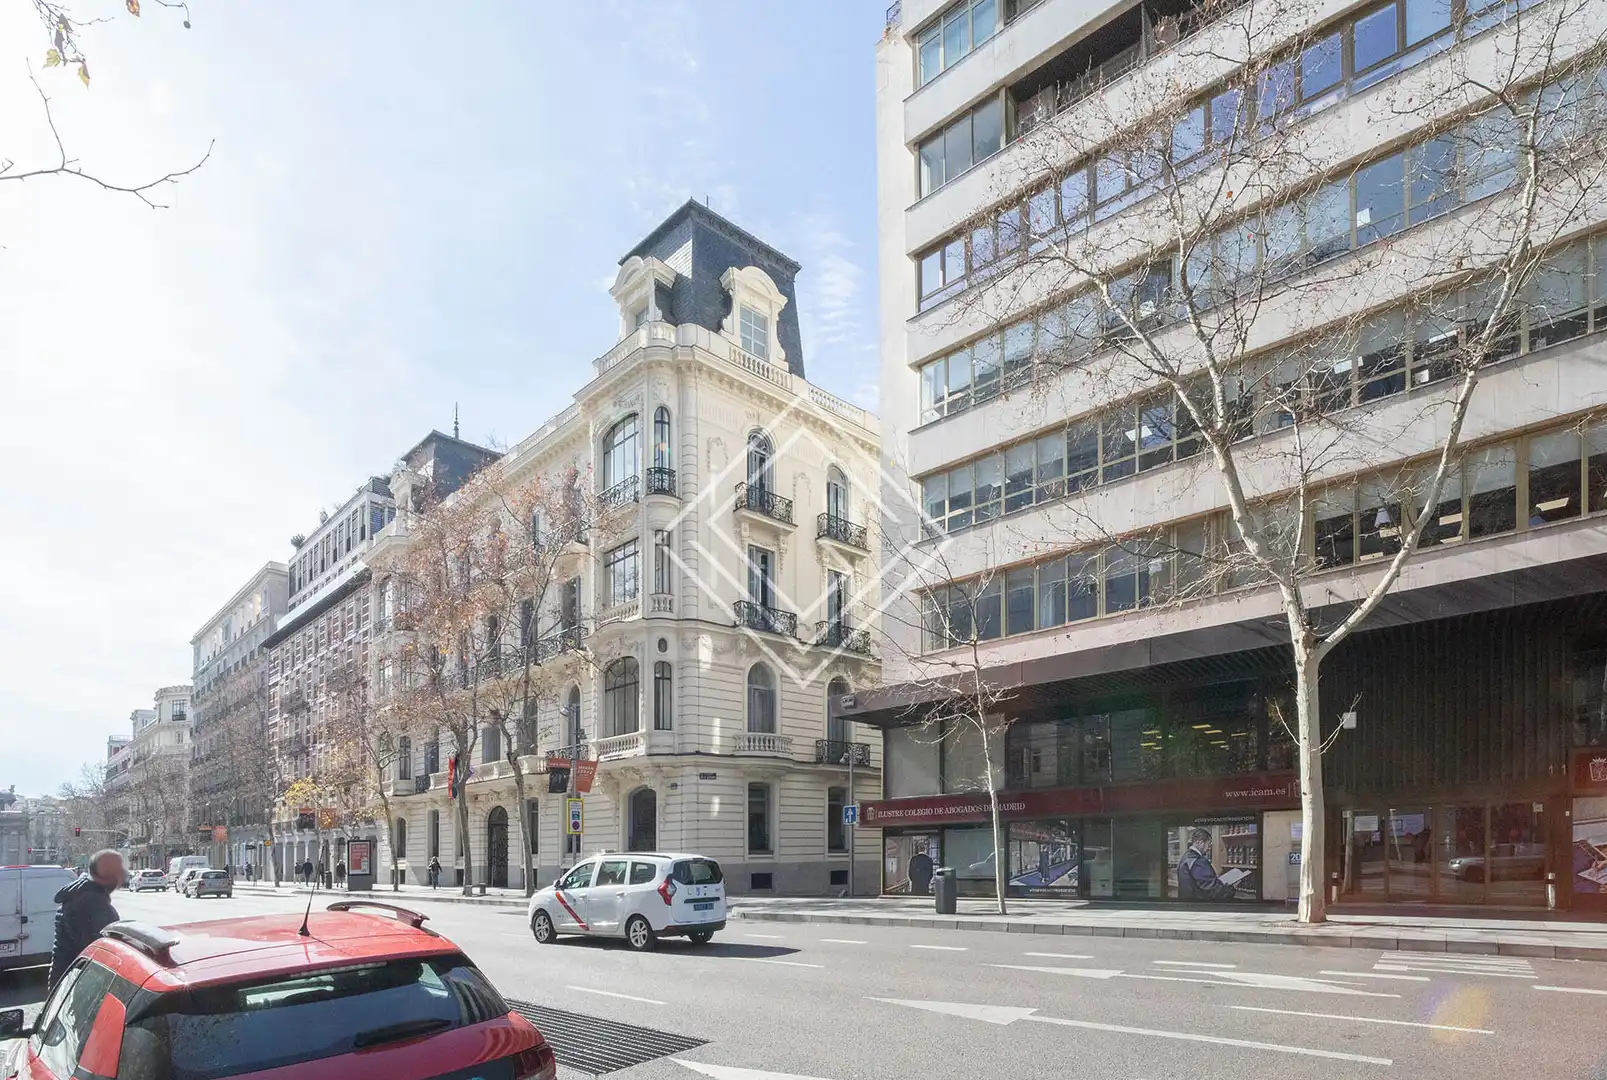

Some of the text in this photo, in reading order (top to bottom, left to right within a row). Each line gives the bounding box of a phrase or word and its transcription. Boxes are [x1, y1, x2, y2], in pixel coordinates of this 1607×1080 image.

[1224, 787, 1286, 798] www.icam.es
[878, 809, 904, 818] ILUSTRE
[904, 807, 933, 817] COLEGIO
[934, 807, 944, 815] DE
[944, 804, 983, 814] ABOGADOS
